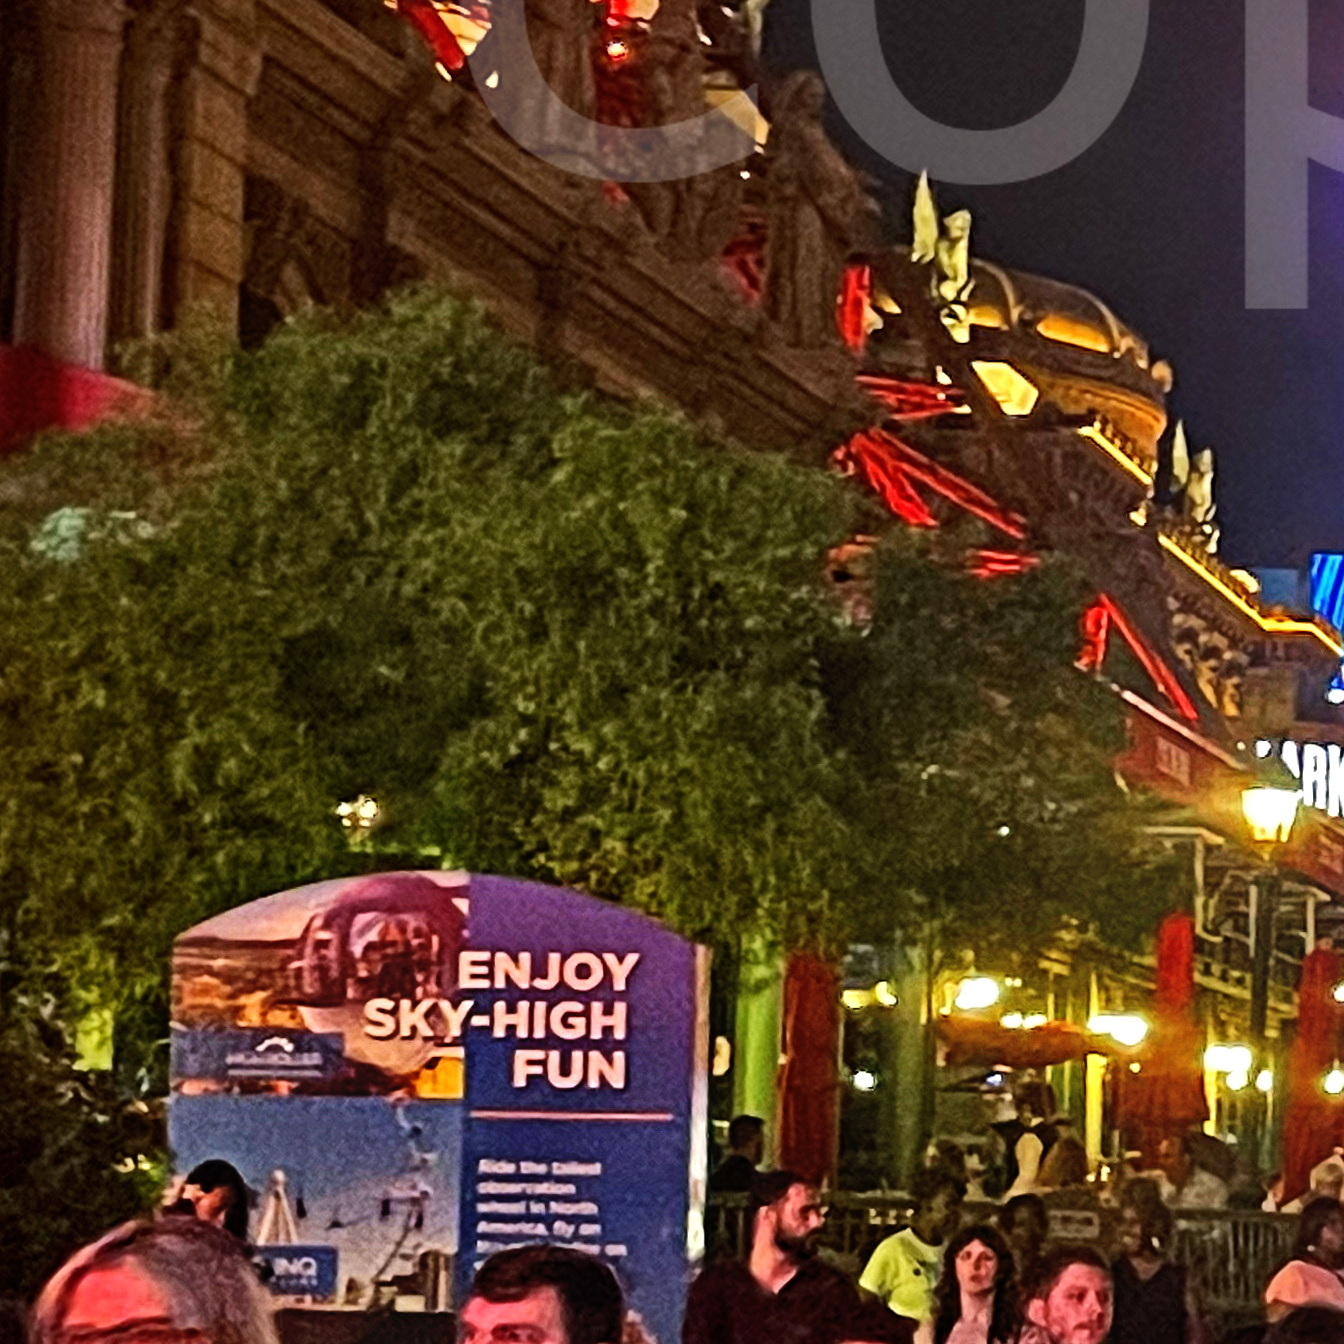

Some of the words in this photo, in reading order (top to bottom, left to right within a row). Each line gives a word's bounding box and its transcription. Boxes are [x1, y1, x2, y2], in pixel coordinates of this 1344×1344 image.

[458, 952, 640, 991] ENJOY
[364, 999, 627, 1040] SKY-HIGH
[514, 1050, 627, 1089] FUN
